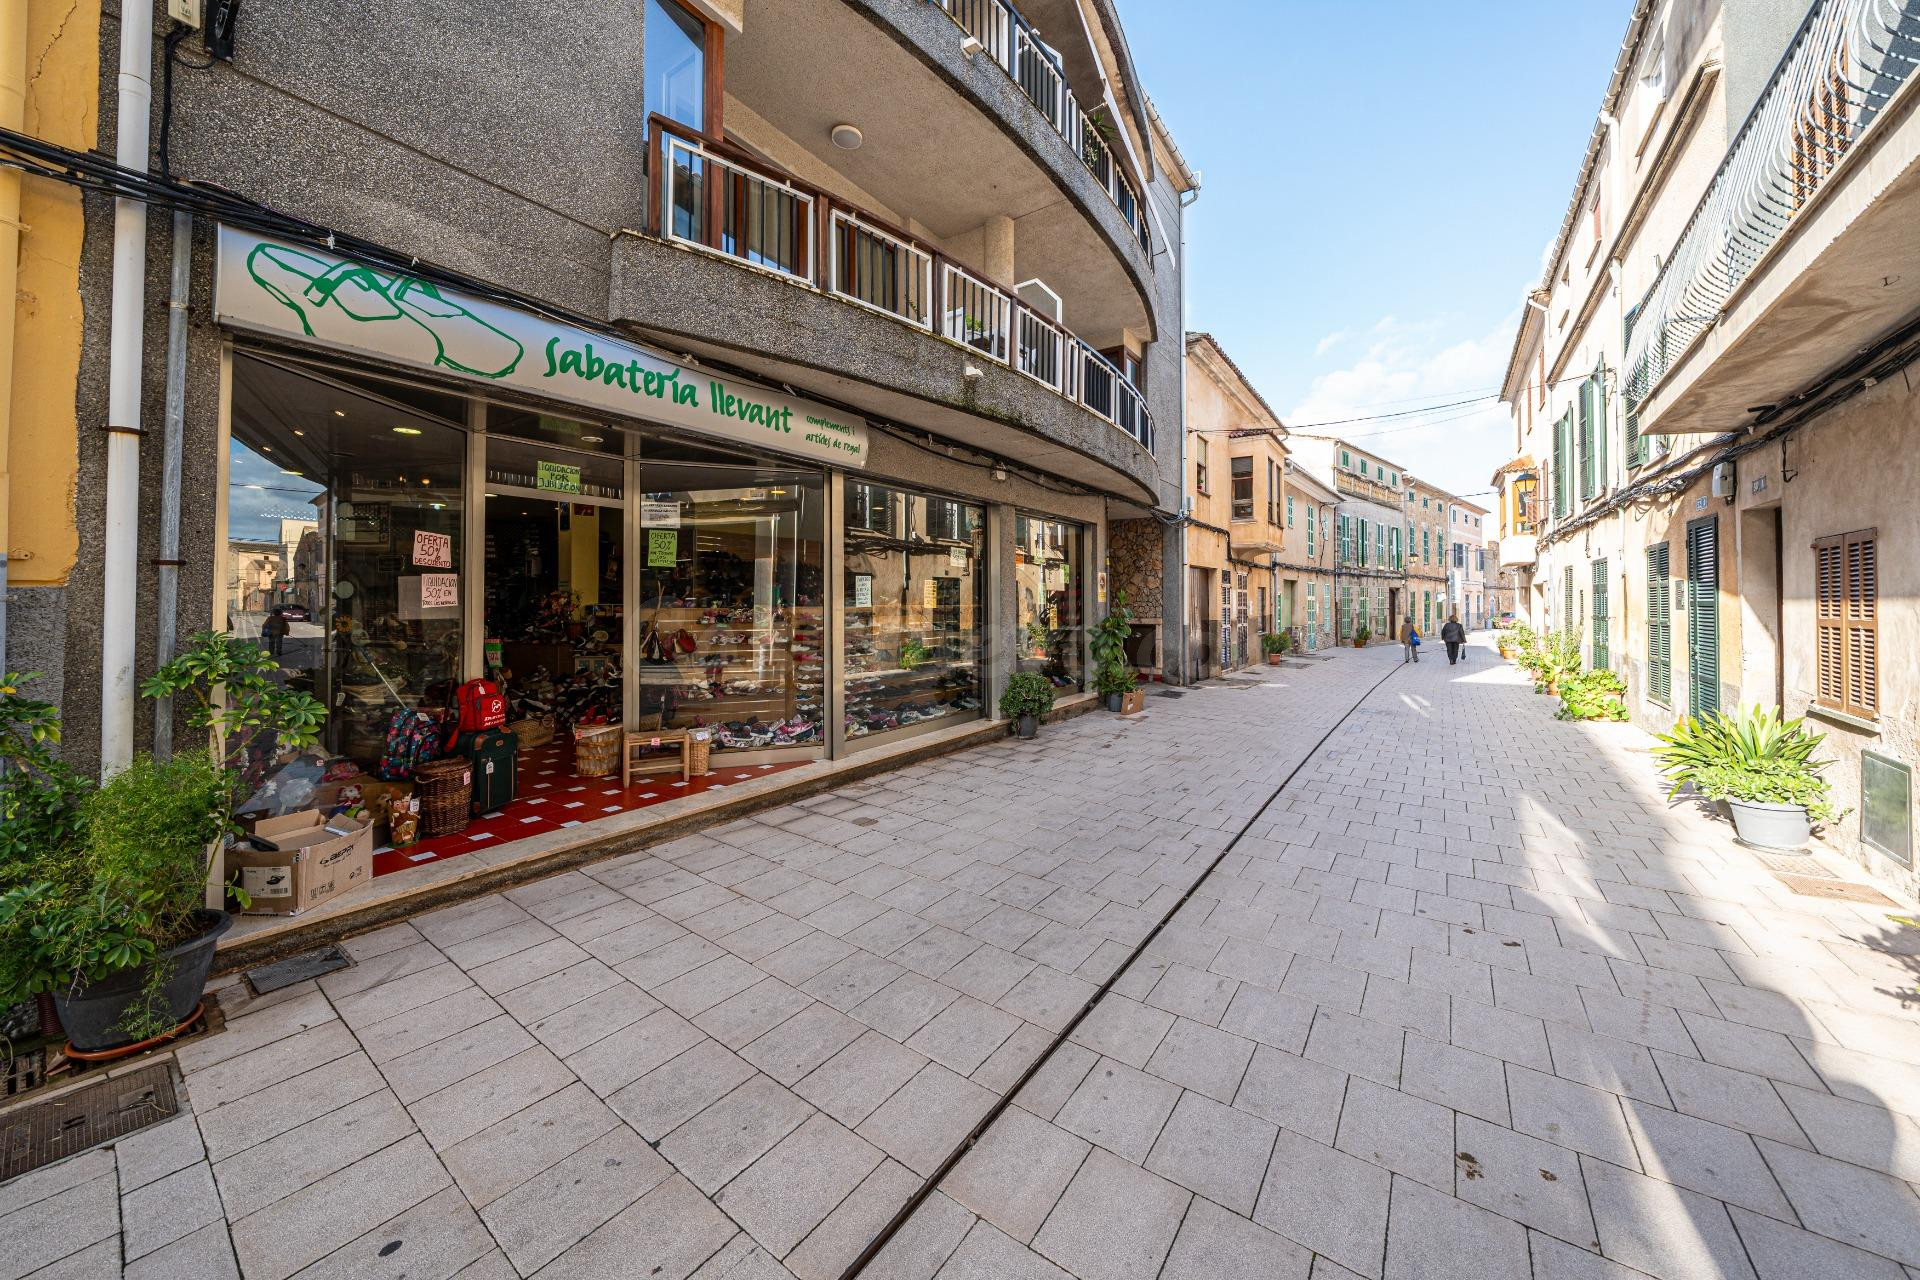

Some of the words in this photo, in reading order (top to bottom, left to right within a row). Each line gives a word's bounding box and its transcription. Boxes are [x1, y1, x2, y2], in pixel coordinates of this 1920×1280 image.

[543, 336, 699, 408] Sabatería
[709, 380, 793, 434] llevant
[806, 415, 851, 437] complements
[832, 438, 842, 449] de
[843, 443, 861, 456] regal
[551, 472, 569, 482] POR
[417, 534, 449, 548] OFERTA
[650, 532, 676, 541] OFERTA
[654, 540, 673, 551] 50%
[420, 545, 441, 561] 50%
[414, 556, 451, 568] DESCUENTO
[424, 588, 443, 601] 50%
[443, 589, 452, 597] EN
